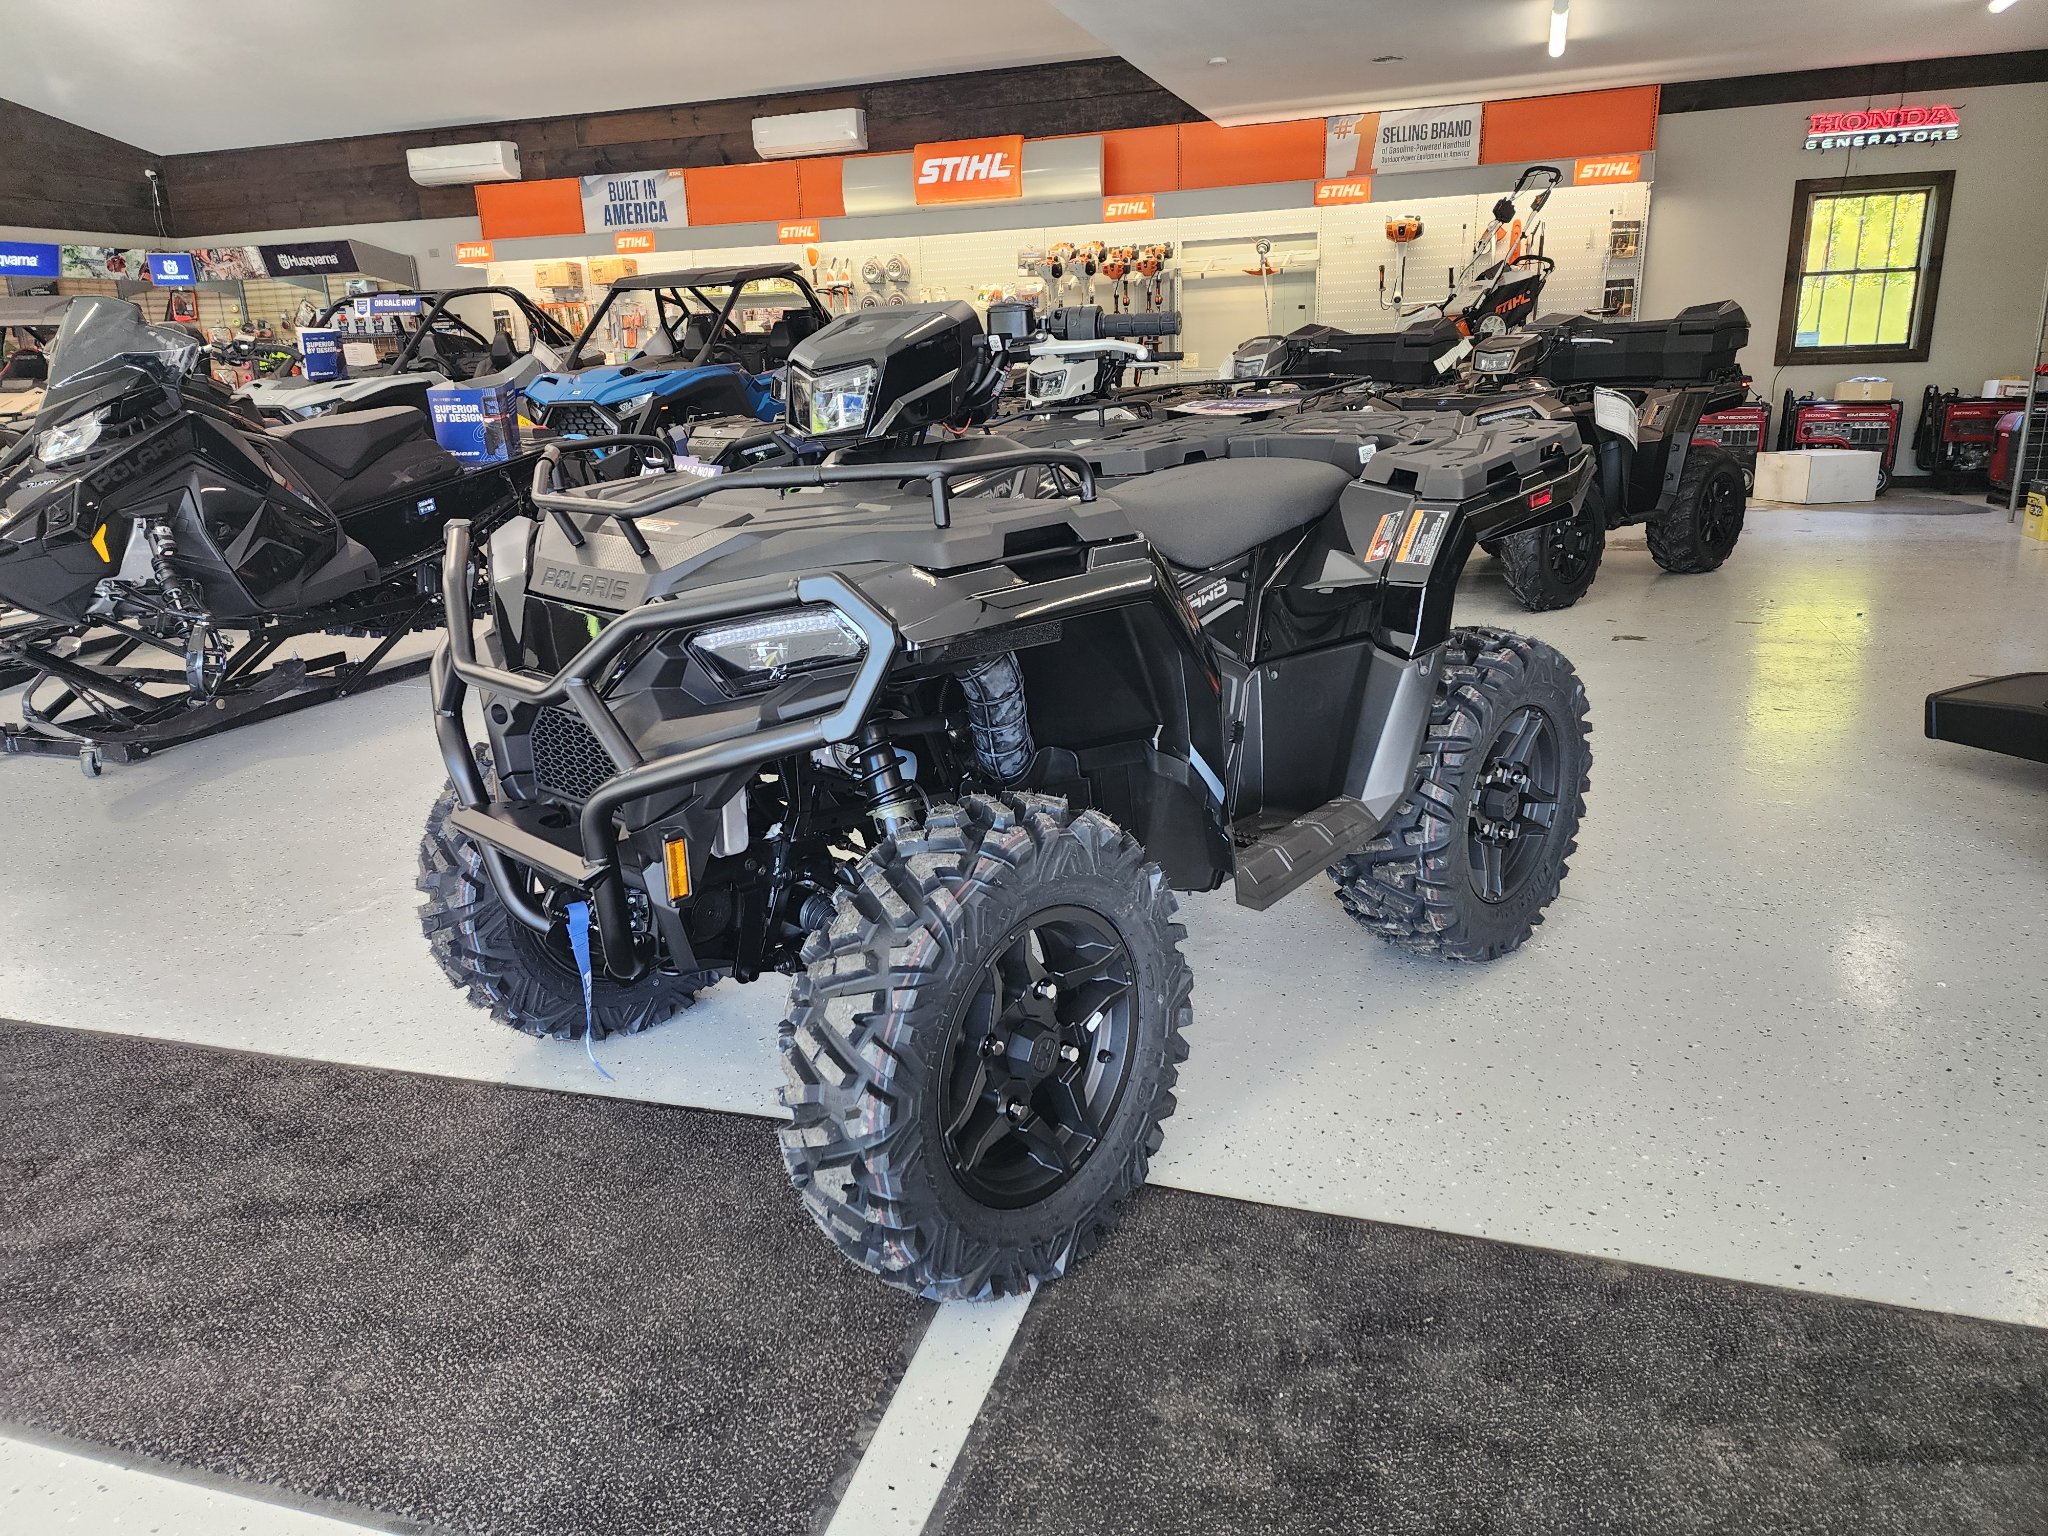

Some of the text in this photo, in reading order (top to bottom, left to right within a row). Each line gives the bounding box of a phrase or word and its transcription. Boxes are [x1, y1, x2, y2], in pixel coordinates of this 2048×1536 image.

[1808, 104, 1960, 135] HONDA
[1382, 119, 1472, 144] SELLING BRAND
[1805, 129, 1959, 150] GENERATORS
[918, 152, 1011, 185] STIHL
[1579, 161, 1633, 178] STIHL
[607, 178, 657, 202] BUILT IN
[1317, 183, 1365, 199] STIHL
[604, 200, 668, 226] AMERICA
[1105, 201, 1148, 217] STIHL
[780, 225, 816, 239] STIHL
[617, 236, 650, 249] STIHL
[458, 246, 489, 258] STIHL
[289, 253, 339, 268] Husqvarna
[157, 273, 189, 281] Husqvarna
[374, 299, 384, 307] ON
[384, 299, 400, 307] SALE
[401, 298, 416, 307] NOW
[1495, 292, 1531, 315] STIHL
[434, 404, 479, 413] SUPERIOR
[436, 414, 483, 423] BY DESIGN
[90, 430, 180, 492] POLAR
[697, 466, 717, 478] NOW
[541, 566, 630, 601] POLARIS
